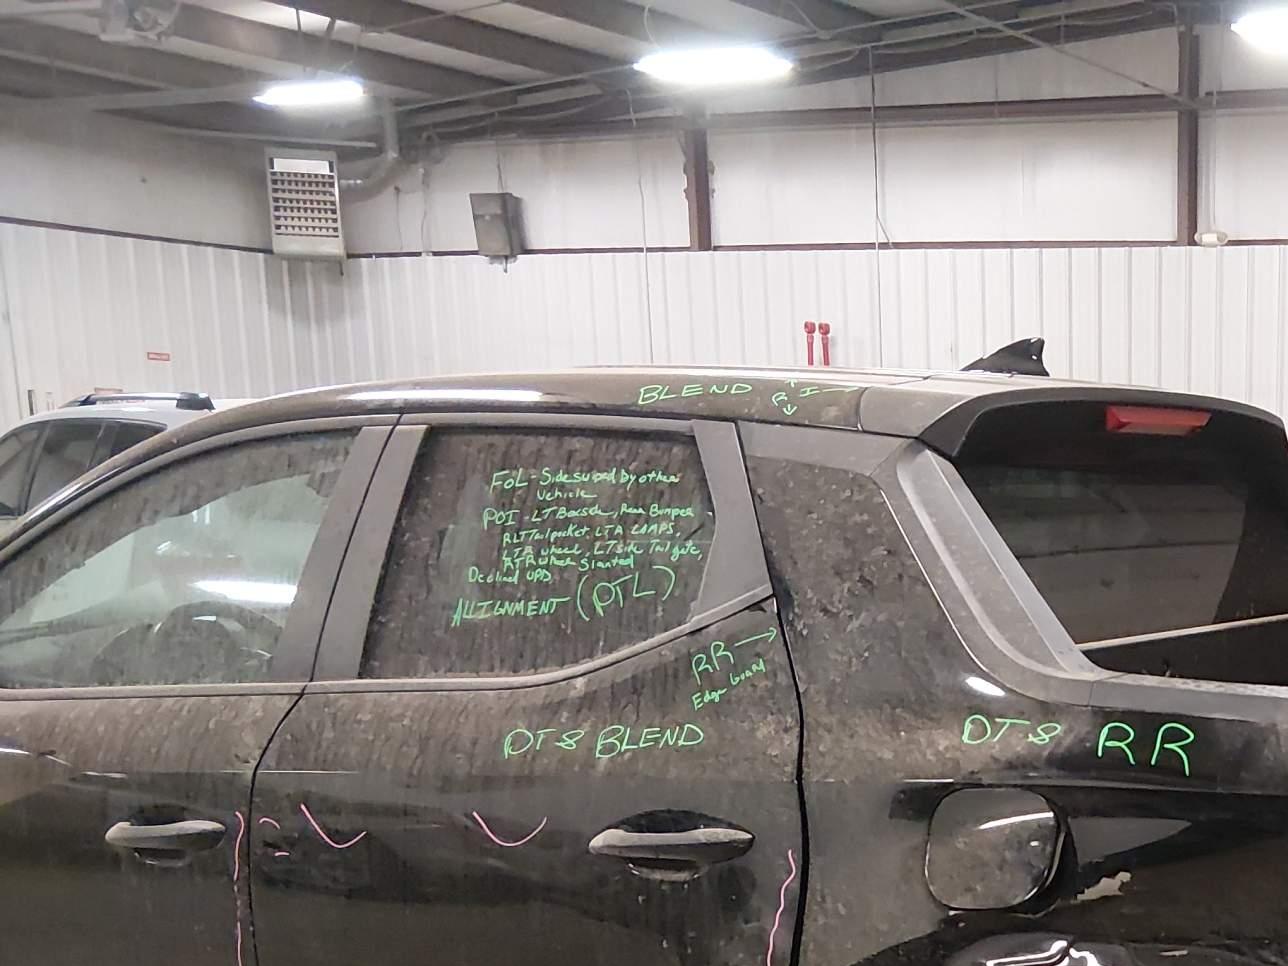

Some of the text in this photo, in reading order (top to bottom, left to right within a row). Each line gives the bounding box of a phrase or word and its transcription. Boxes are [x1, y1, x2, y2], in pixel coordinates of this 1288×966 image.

[638, 382, 753, 406] BLEND
[691, 640, 735, 686] RR
[595, 724, 704, 758] BLEND
[1097, 721, 1196, 777] RR
